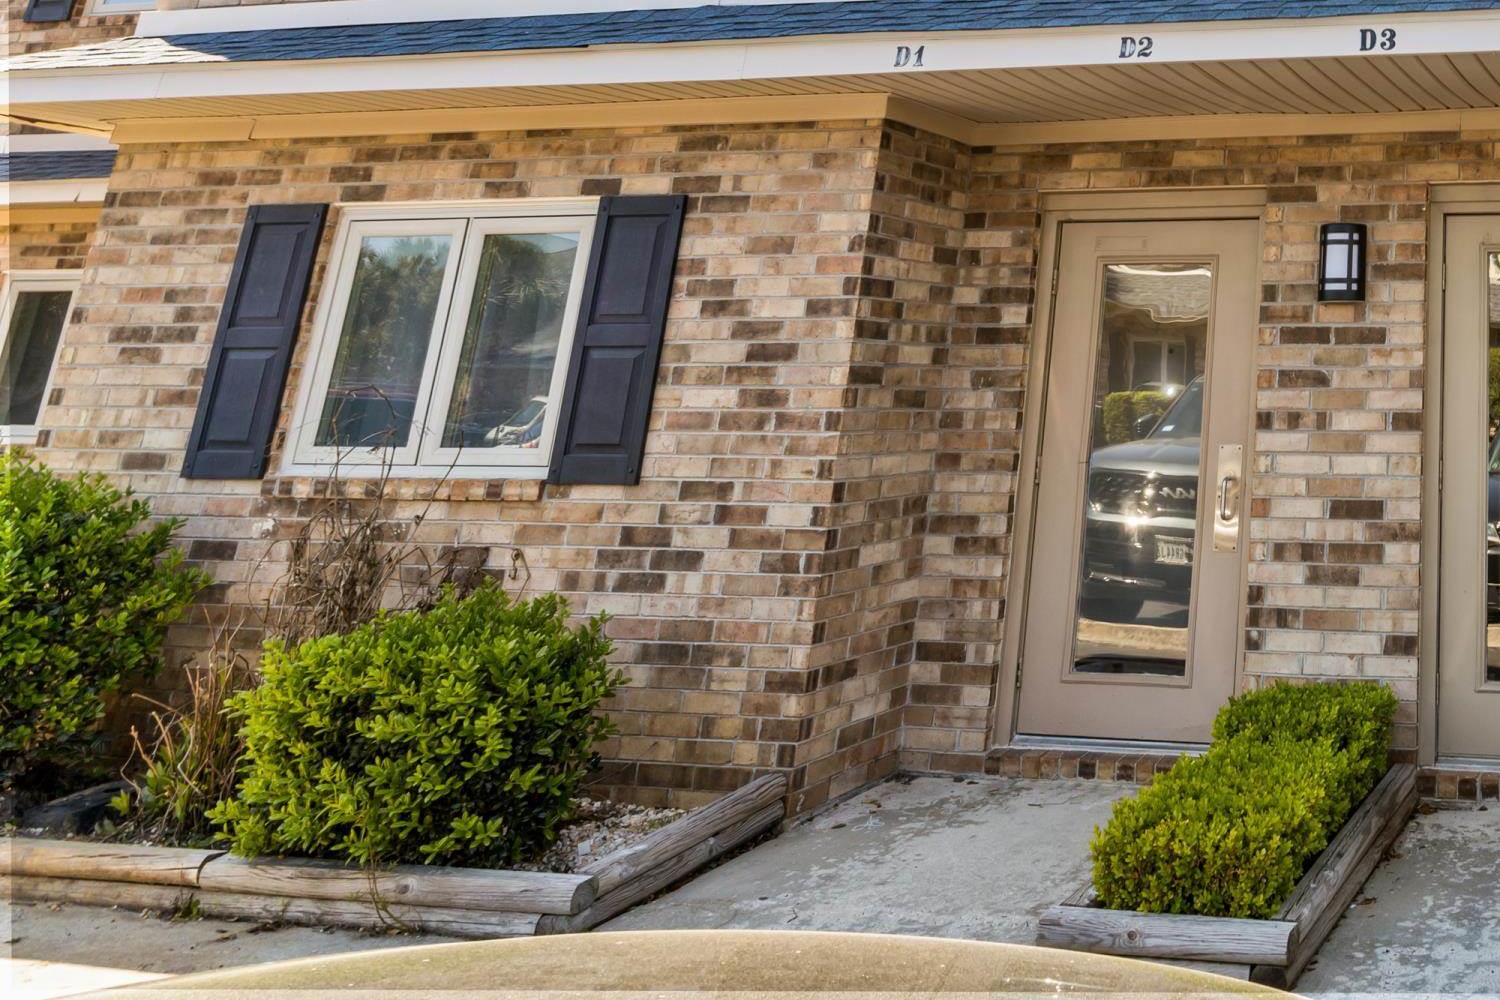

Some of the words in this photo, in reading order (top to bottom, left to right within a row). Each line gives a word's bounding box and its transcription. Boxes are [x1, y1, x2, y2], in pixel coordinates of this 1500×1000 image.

[1118, 36, 1154, 58] D2
[1359, 28, 1397, 51] D3
[893, 45, 925, 67] D1
